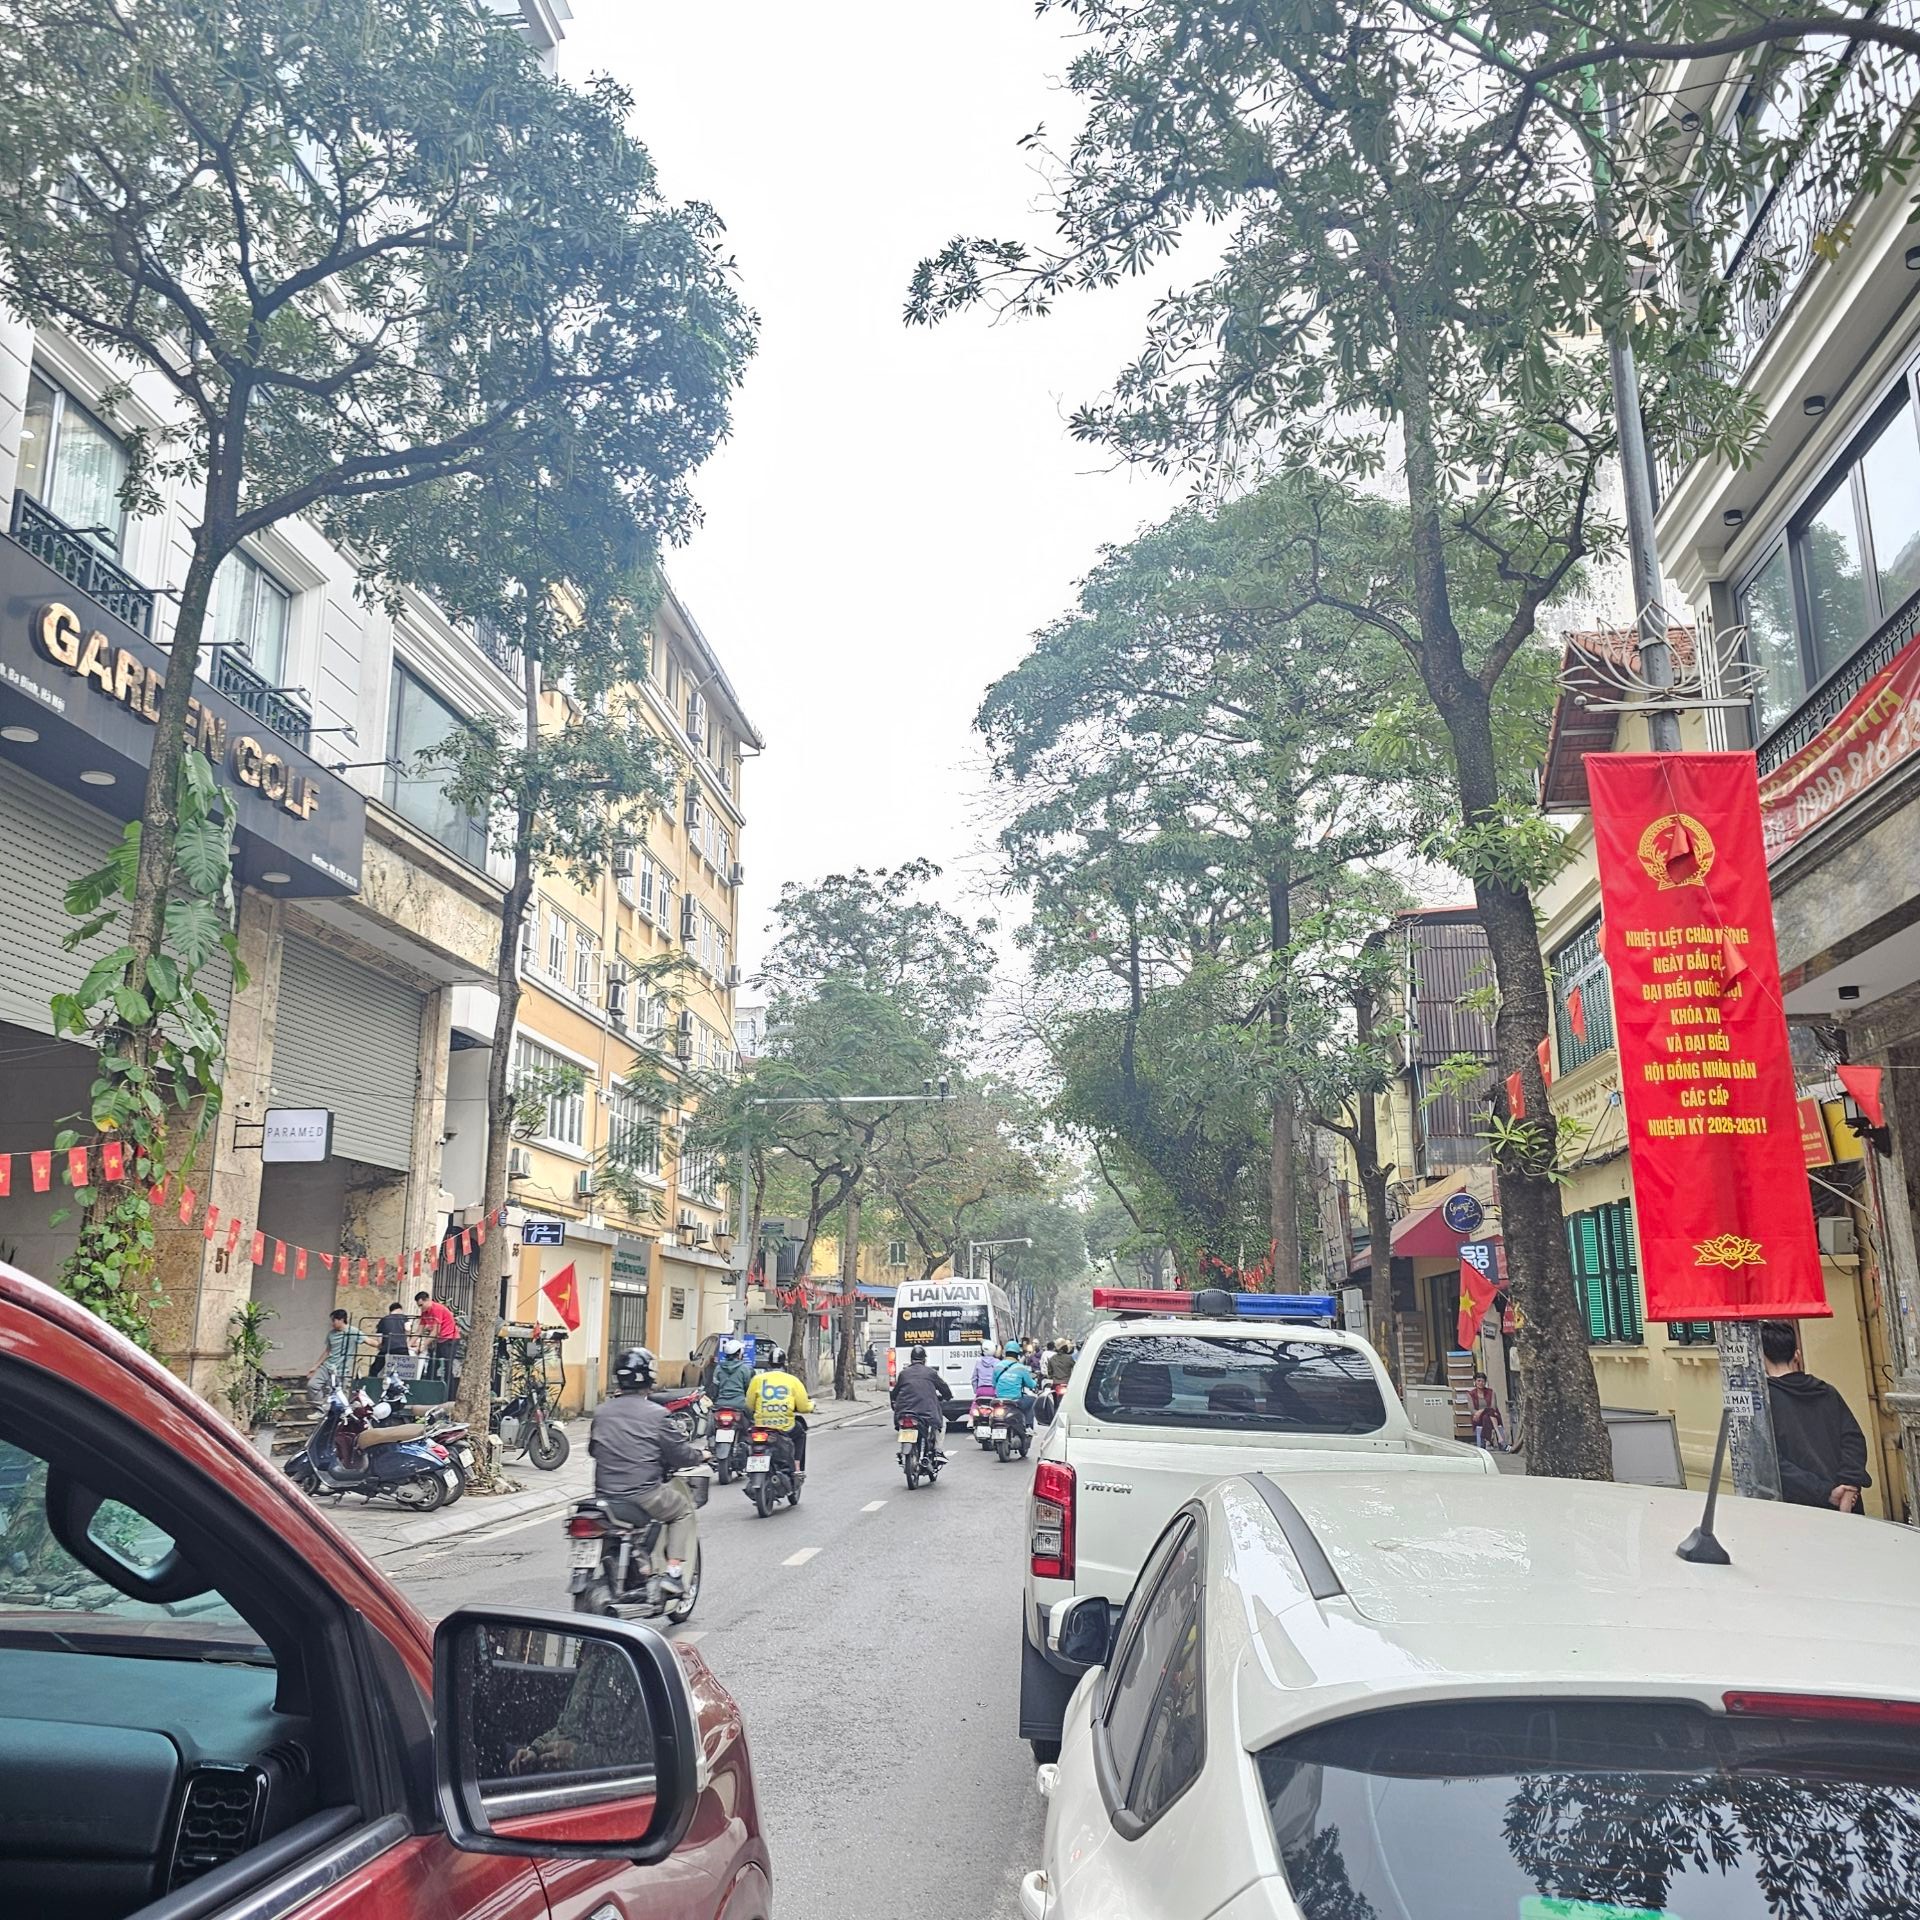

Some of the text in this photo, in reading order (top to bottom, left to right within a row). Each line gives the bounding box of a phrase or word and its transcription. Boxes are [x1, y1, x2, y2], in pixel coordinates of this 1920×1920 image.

[36, 602, 320, 821] GARDEN GOLF
[1625, 928, 1657, 950] NHIỆT
[1659, 927, 1683, 949] LIỆT
[1685, 924, 1714, 943] CHÀO
[1653, 953, 1684, 974] NGÀY
[1686, 948, 1709, 971] BẦU
[1642, 984, 1662, 1004] ĐẠI
[1664, 975, 1692, 1000] BIỂU
[1694, 976, 1720, 998] QUỐC
[1670, 1005, 1721, 1025] KHÓA XVI
[1666, 1029, 1730, 1055] VÀ ĐẠI BIỂU
[1644, 1058, 1757, 1085] HỘI ĐỒNG NHÂN DÂN
[1681, 1083, 1729, 1108] CÁC CẤP
[267, 1126, 324, 1137] PARAMED
[1648, 1114, 1768, 1140] NHIỆM KỲ 2026-2031!
[215, 1248, 230, 1274] 51
[762, 1379, 788, 1401] be
[1731, 1395, 1750, 1404] MAY
[1084, 1481, 1133, 1494] TRITON
